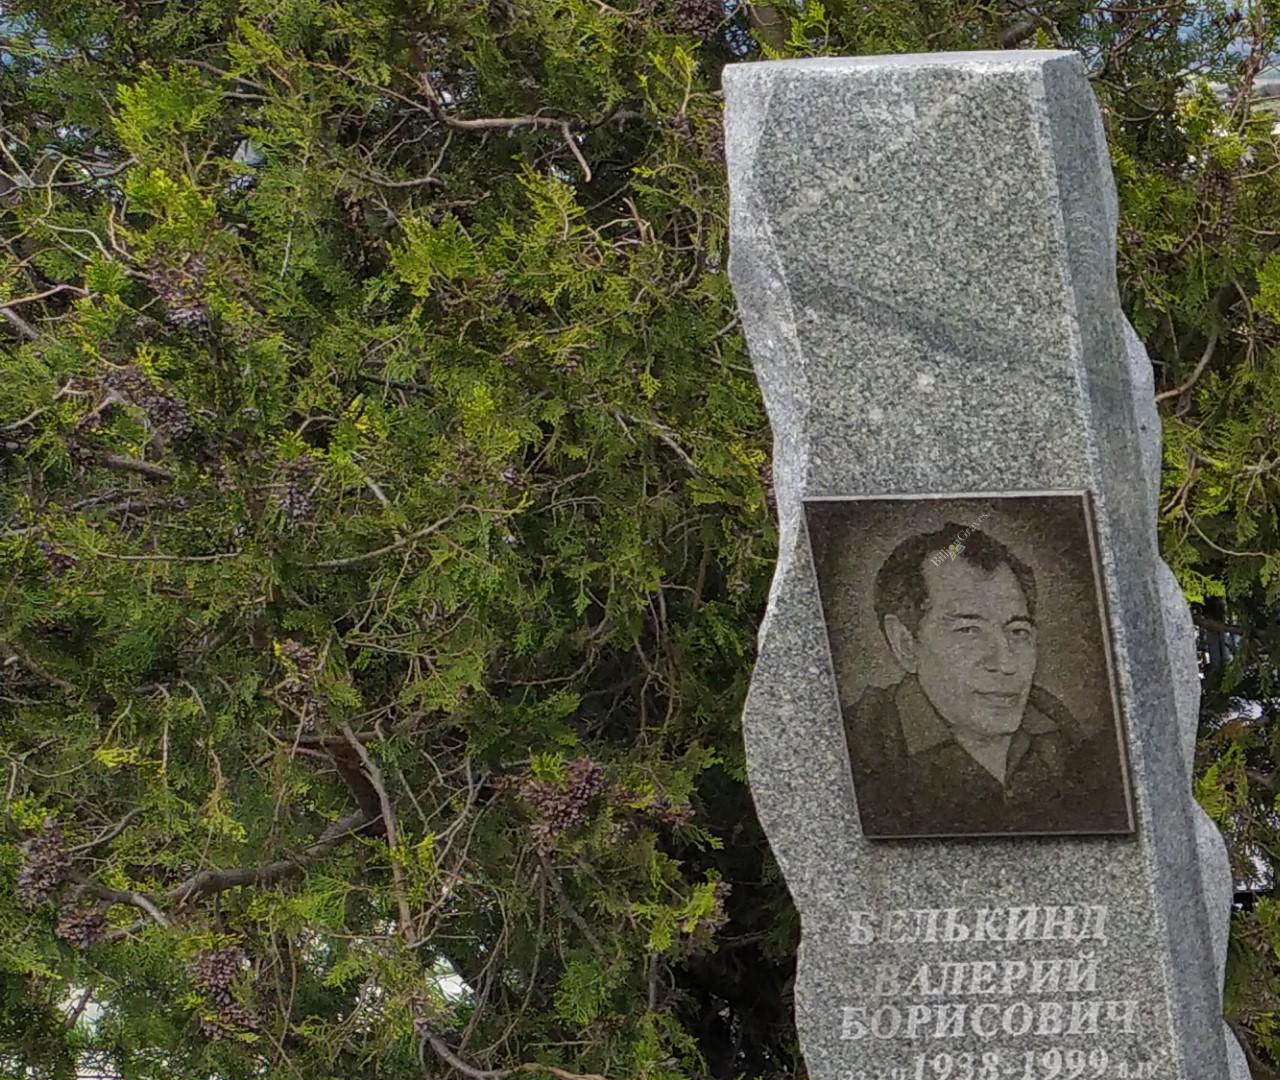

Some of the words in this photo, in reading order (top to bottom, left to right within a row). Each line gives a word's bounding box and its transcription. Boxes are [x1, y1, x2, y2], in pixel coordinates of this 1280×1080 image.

[847, 902, 1108, 946] БЕЛЬКИНД
[873, 950, 1101, 997] ВАЛЕРИЙ
[840, 1000, 1140, 1041] БОРИСОВИЧ
